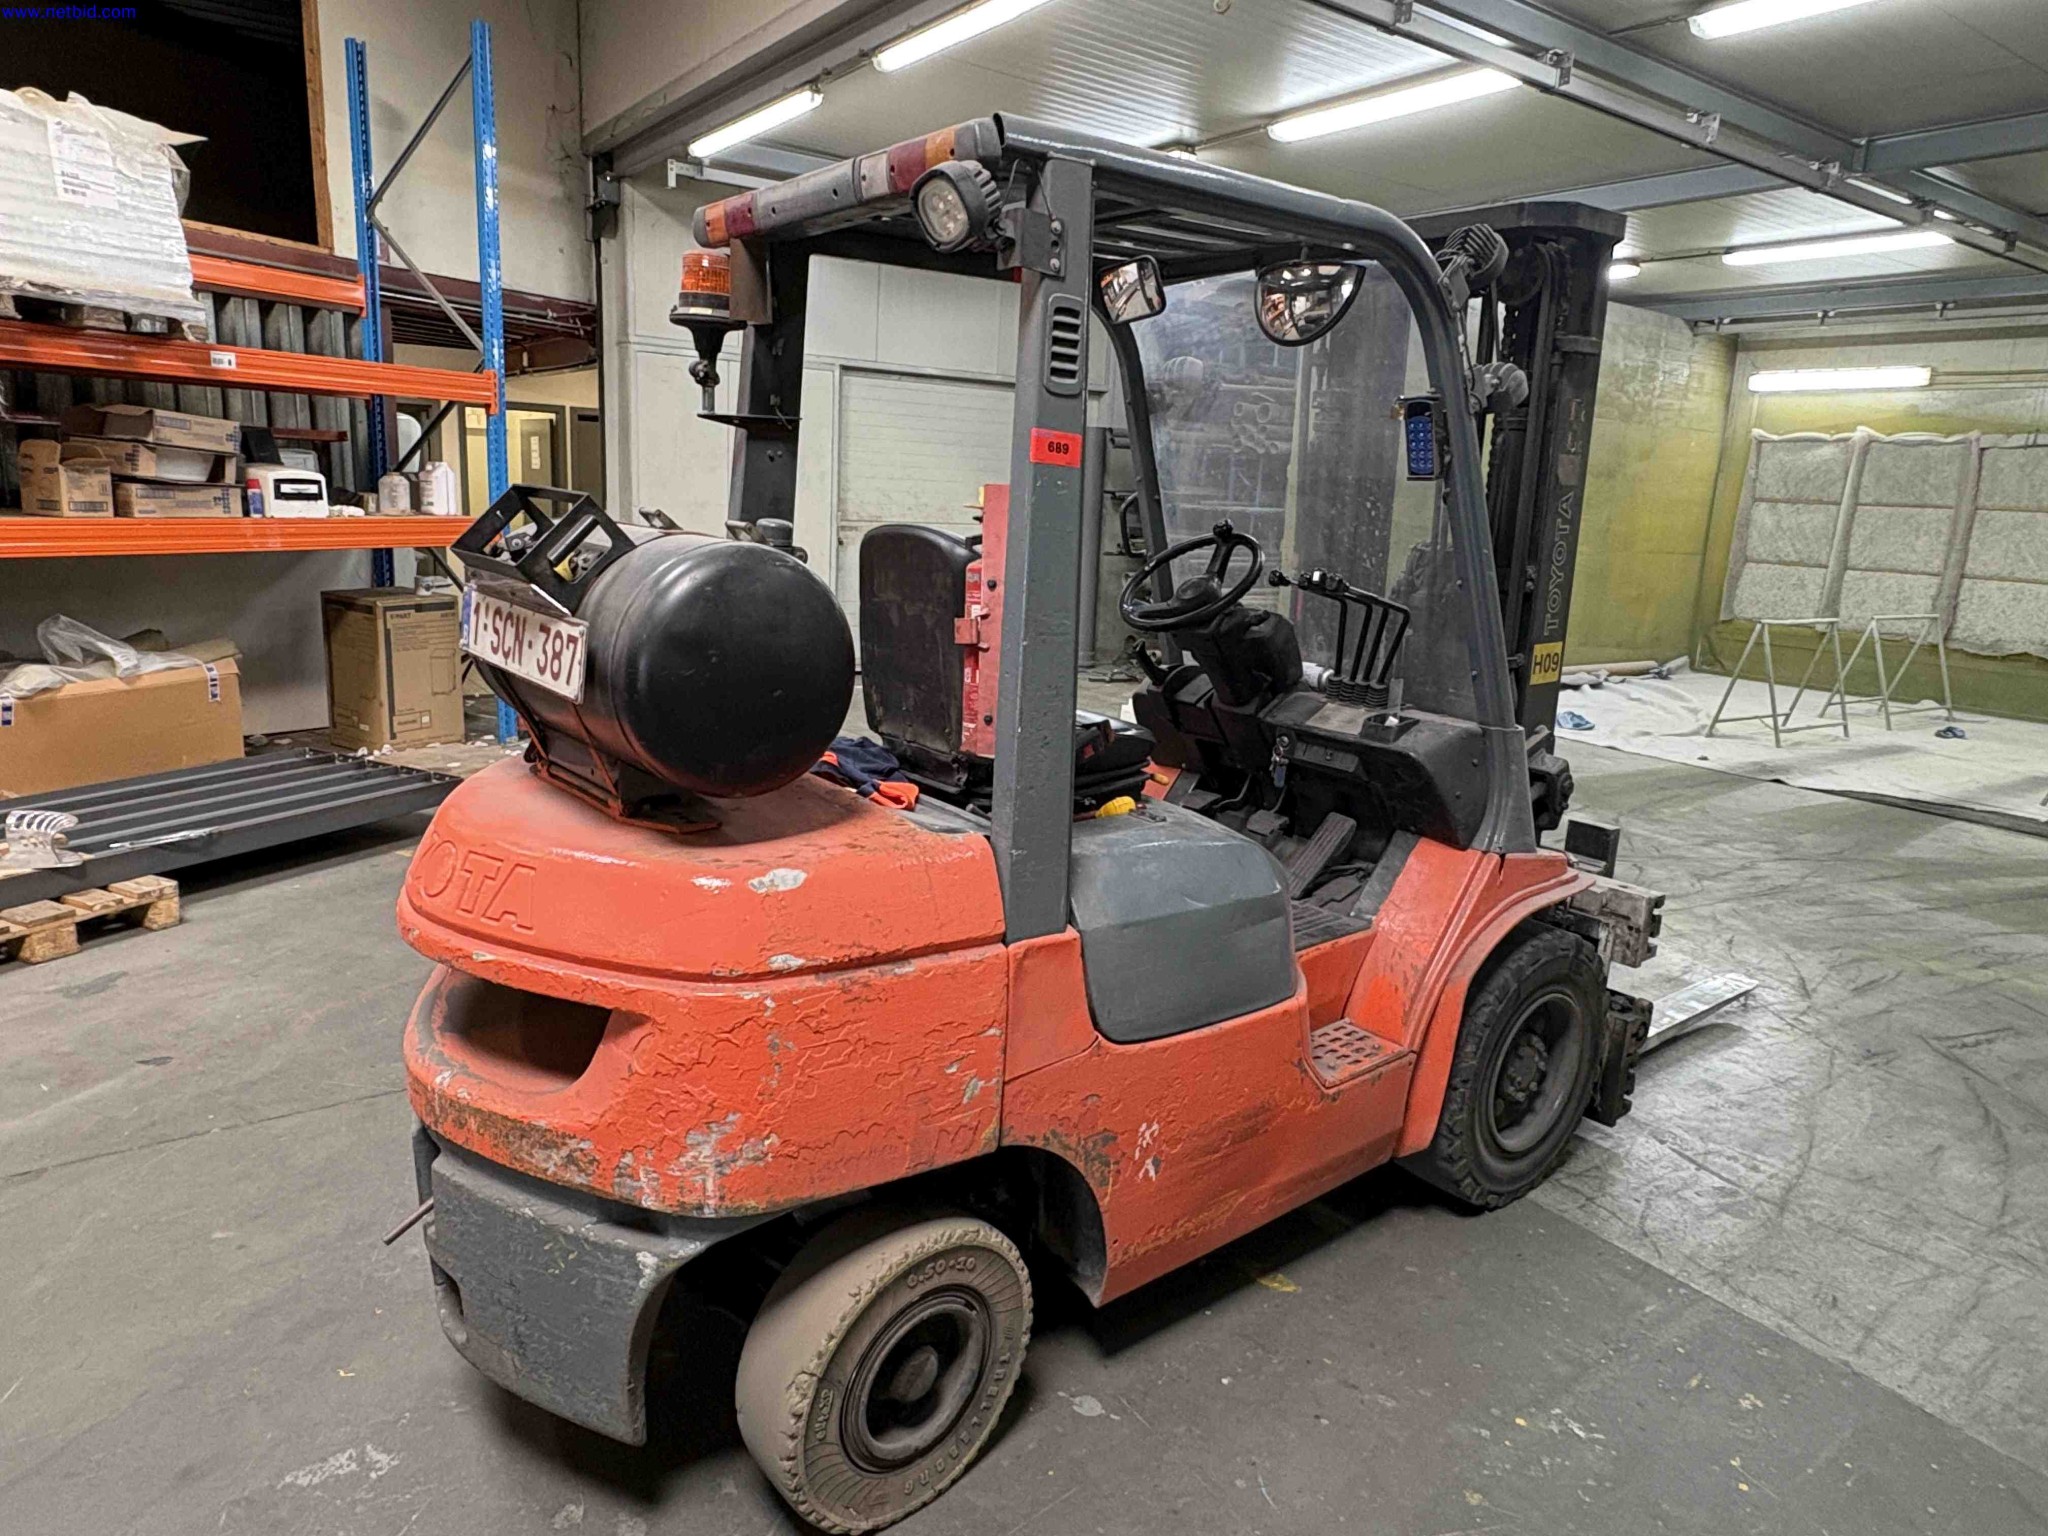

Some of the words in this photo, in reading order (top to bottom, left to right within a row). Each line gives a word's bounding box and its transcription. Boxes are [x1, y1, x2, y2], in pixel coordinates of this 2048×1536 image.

[1048, 441, 1069, 455] 689
[1544, 491, 1574, 637] TOYOTA
[1533, 652, 1559, 675] H09
